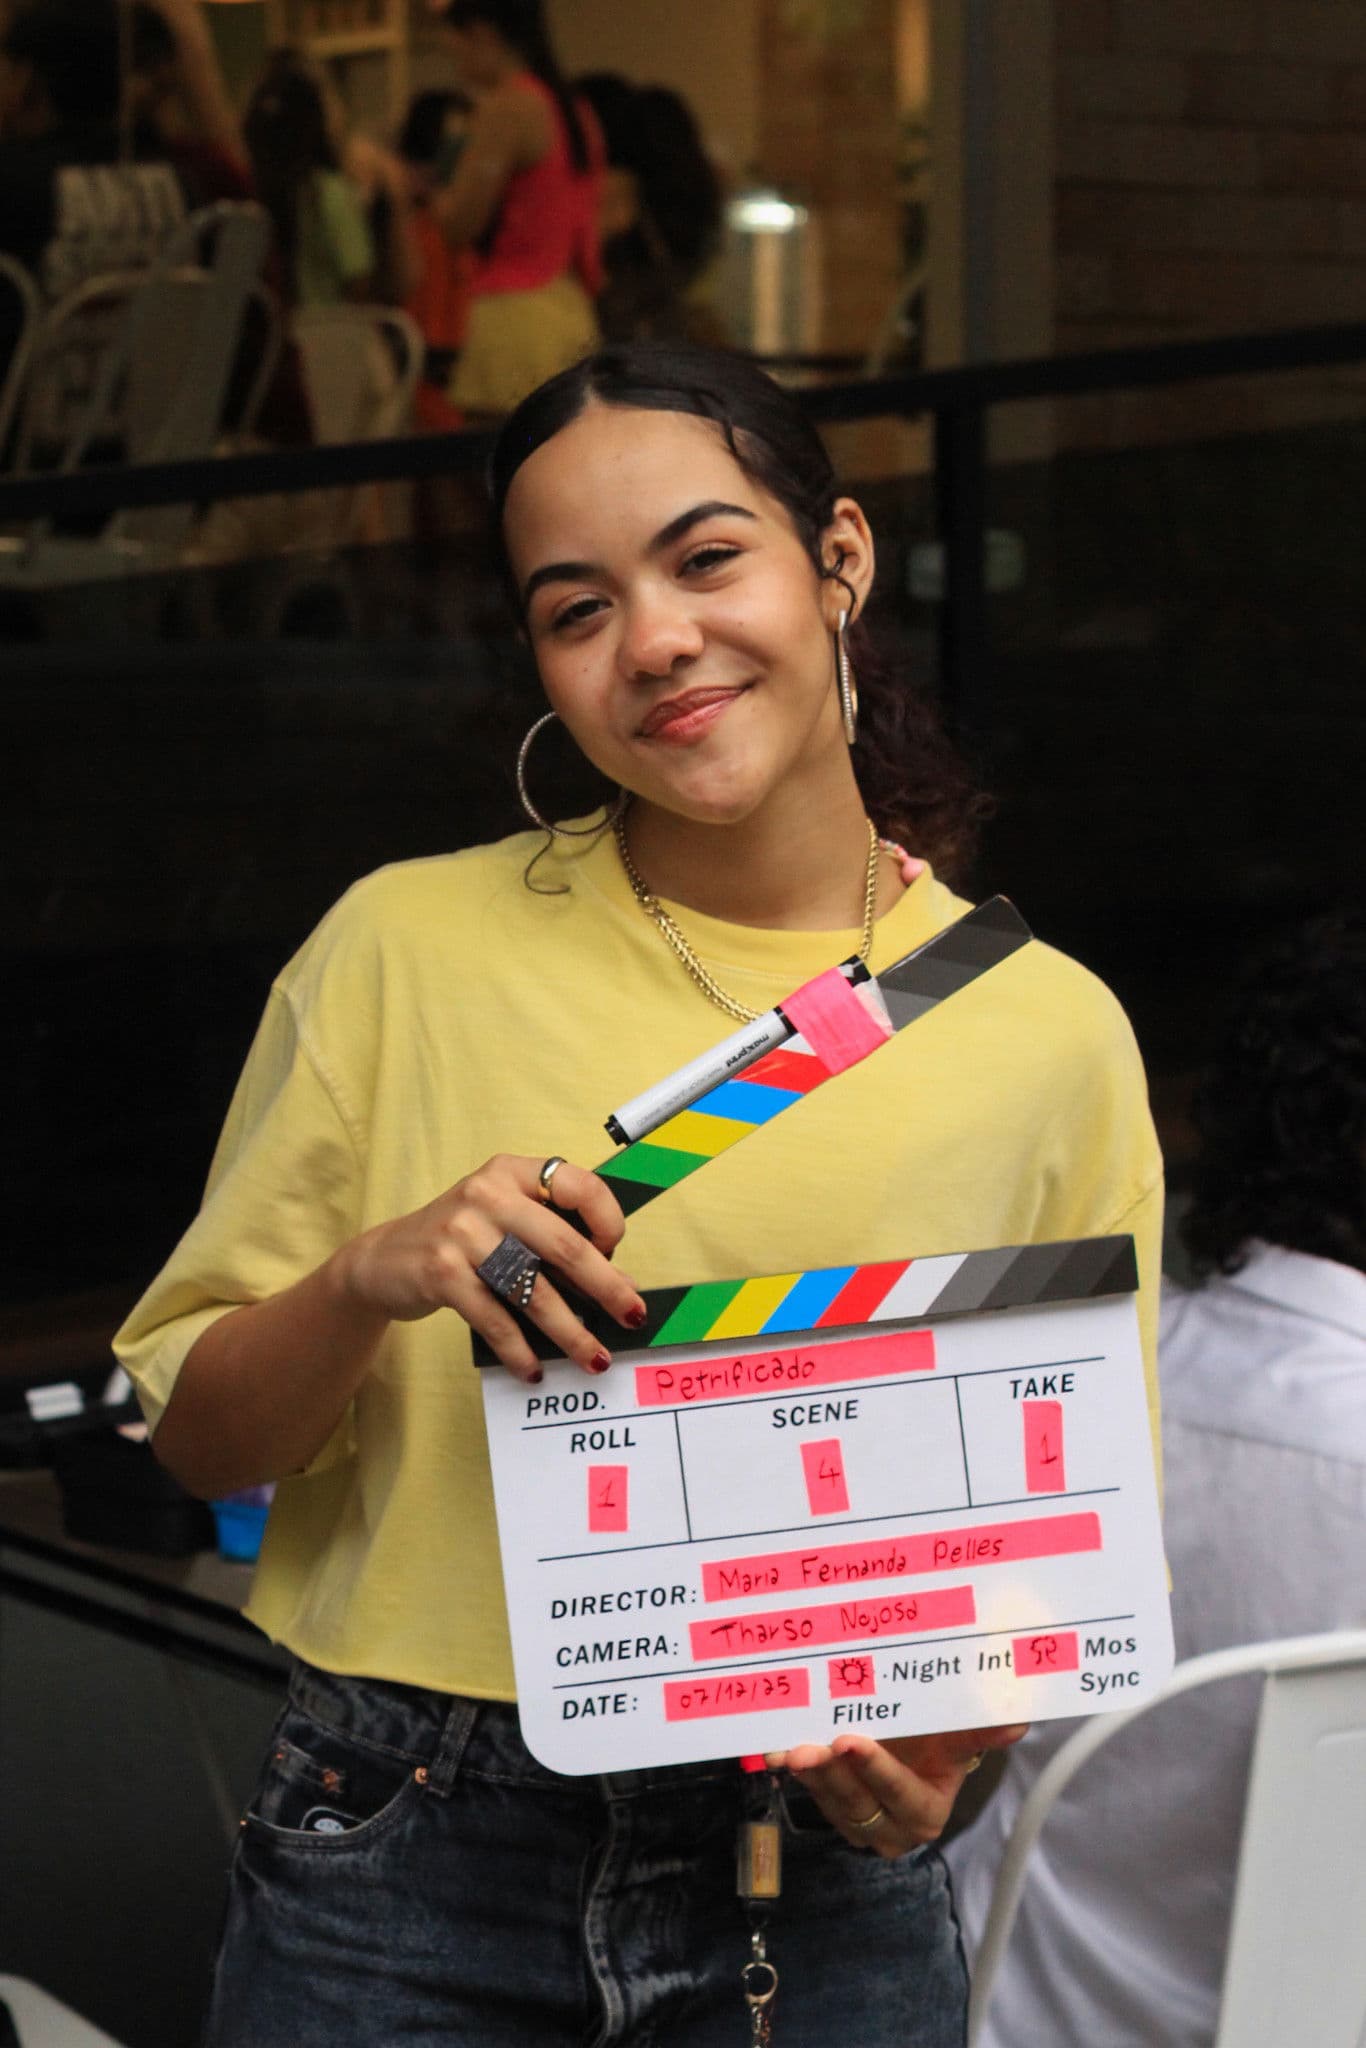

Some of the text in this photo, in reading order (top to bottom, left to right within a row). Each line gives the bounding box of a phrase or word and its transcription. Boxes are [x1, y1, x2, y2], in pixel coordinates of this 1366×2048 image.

[655, 1356, 816, 1401] Petrificado
[1009, 1373, 1075, 1399] TAKE
[526, 1391, 605, 1418] PROD.
[772, 1399, 859, 1428] SCENE
[570, 1427, 636, 1453] ROLL
[1039, 1432, 1058, 1465] 1
[818, 1456, 840, 1488] 4
[719, 1567, 779, 1594] Maria
[801, 1547, 907, 1582] Fernanda
[551, 1584, 697, 1619] DIRECTOR:
[556, 1635, 679, 1667] CAMERA:
[978, 1648, 1012, 1671] Int
[1085, 1636, 1137, 1659] Mos
[680, 1674, 792, 1709] 07/12/25
[1079, 1668, 1140, 1696] Sync
[562, 1692, 638, 1721] DATE:
[832, 1702, 902, 1725] Filter
